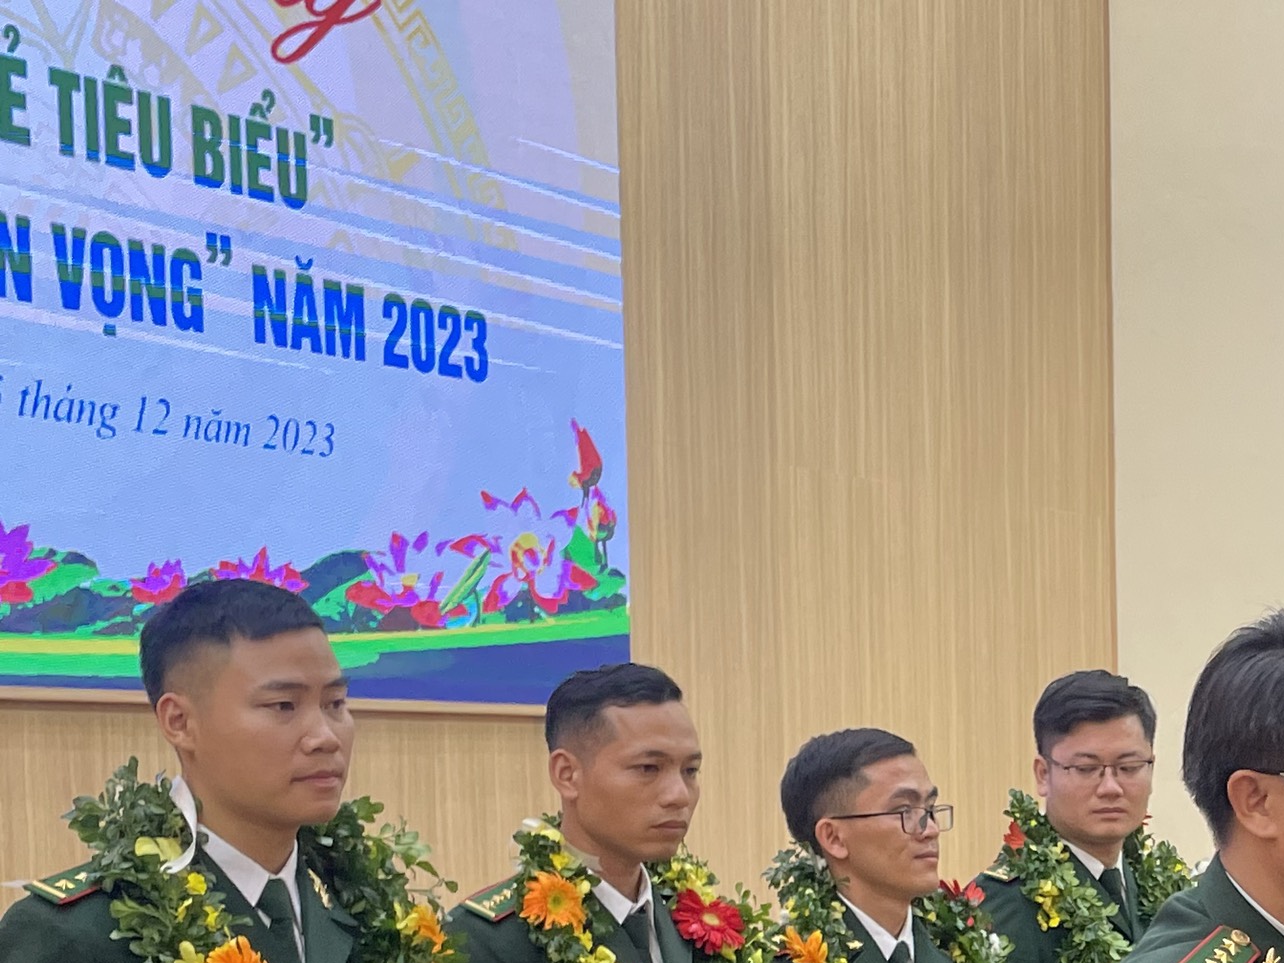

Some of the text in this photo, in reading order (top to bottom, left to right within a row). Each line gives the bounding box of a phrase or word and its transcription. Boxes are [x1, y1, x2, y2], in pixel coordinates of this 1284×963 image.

[49, 65, 172, 178] TIÊU
[252, 256, 366, 362] NĂM
[383, 293, 488, 383] 2023
[18, 380, 119, 440] tháng
[131, 395, 171, 435] 12
[183, 409, 250, 448] năm
[263, 414, 335, 458] 2023
